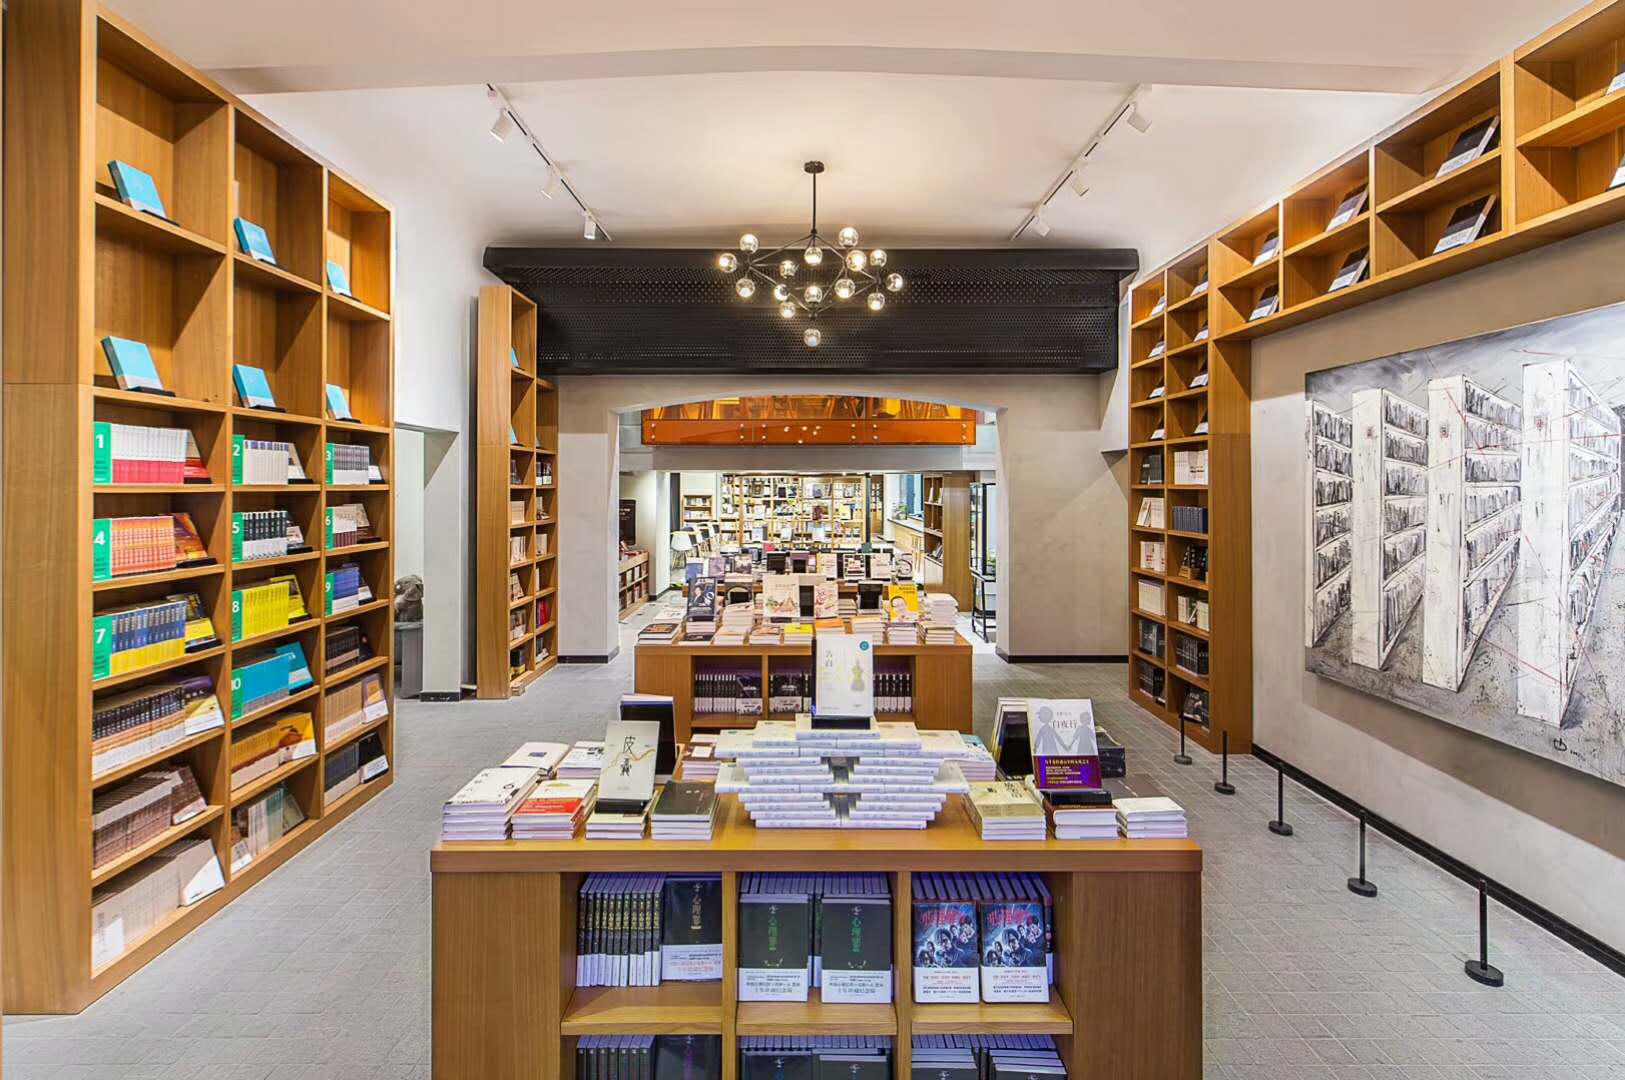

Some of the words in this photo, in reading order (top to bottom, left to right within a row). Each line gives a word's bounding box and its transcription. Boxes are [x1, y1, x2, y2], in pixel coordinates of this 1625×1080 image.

[95, 433, 104, 448] 1
[232, 444, 240, 456] 2
[325, 450, 332, 461] 3
[325, 515, 331, 526] 6
[232, 521, 240, 534] 5
[93, 530, 106, 545] 4
[325, 581, 331, 593] 9
[232, 600, 240, 613] 8
[95, 628, 106, 644] 7
